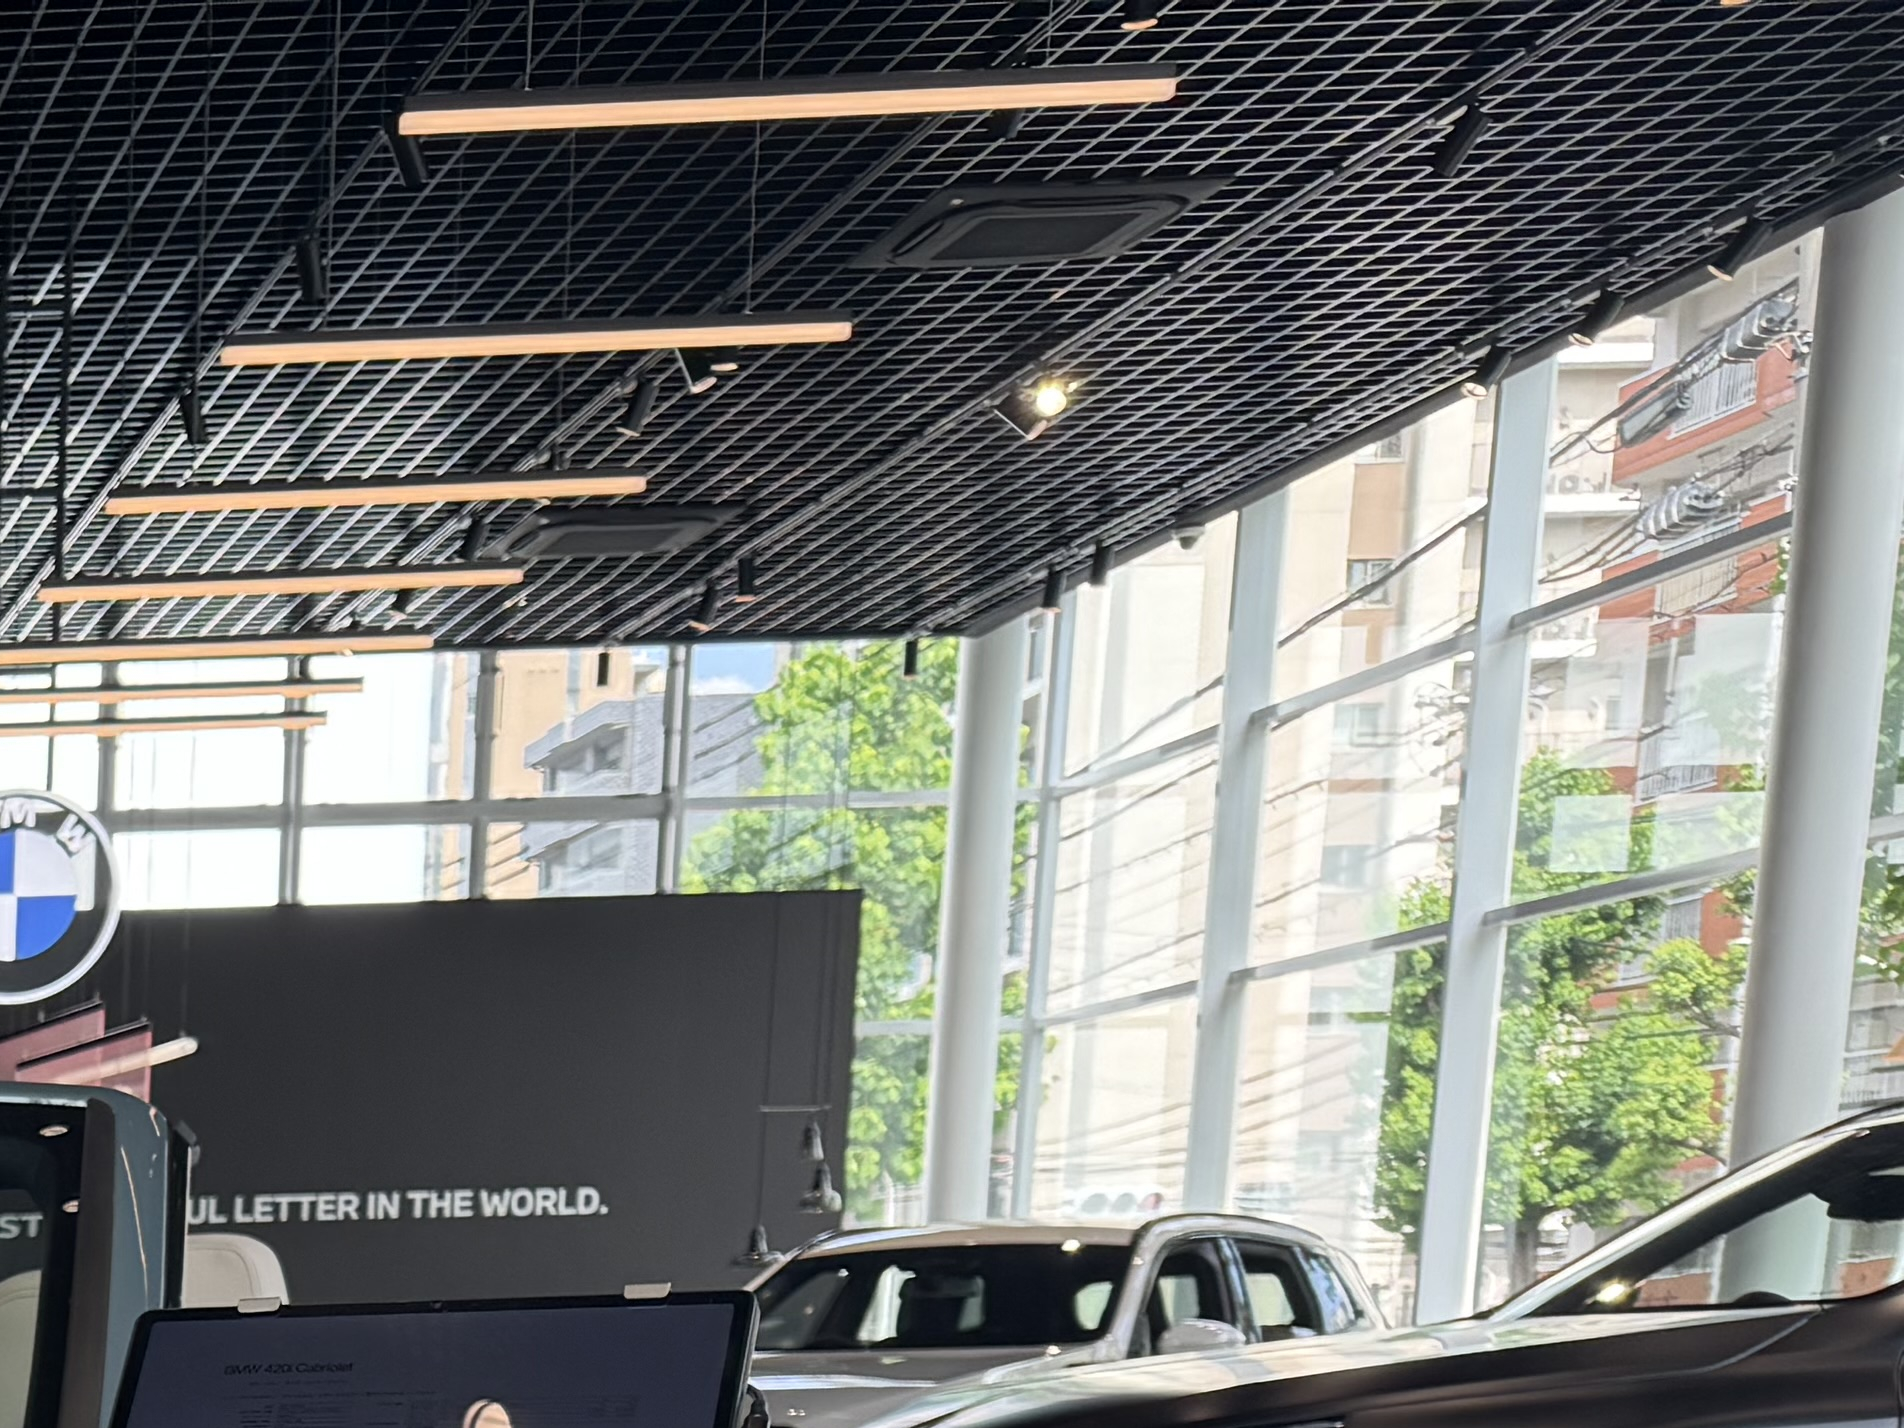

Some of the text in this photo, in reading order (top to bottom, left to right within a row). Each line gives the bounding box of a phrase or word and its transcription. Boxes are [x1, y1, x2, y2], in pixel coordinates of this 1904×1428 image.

[234, 1193, 360, 1223] LETTER
[367, 1191, 400, 1220] IN
[407, 1188, 474, 1219] THE
[481, 1186, 609, 1218] WORLD.
